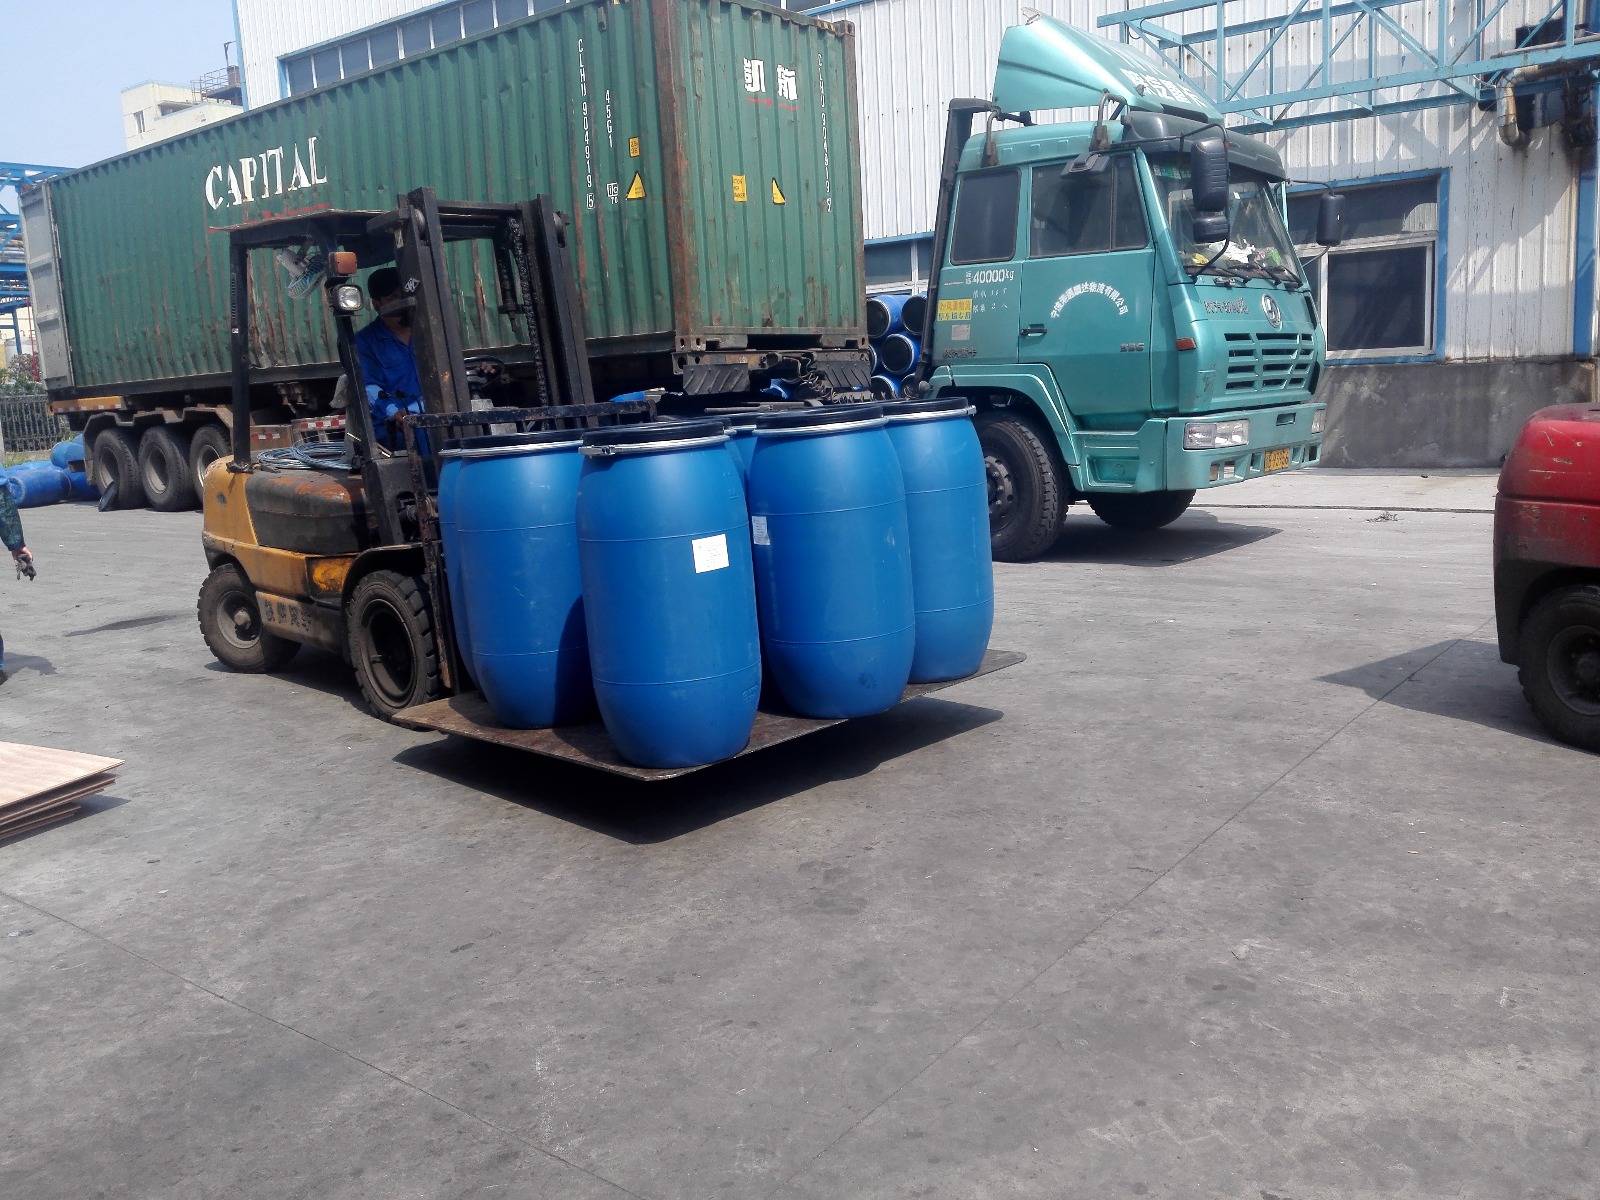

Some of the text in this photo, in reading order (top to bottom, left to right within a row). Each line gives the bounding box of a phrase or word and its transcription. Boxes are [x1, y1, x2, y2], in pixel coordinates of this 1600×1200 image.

[578, 38, 587, 97] CLHU
[582, 101, 592, 188] 904919
[605, 89, 613, 148] 45G1
[205, 136, 328, 210] CAPITAL
